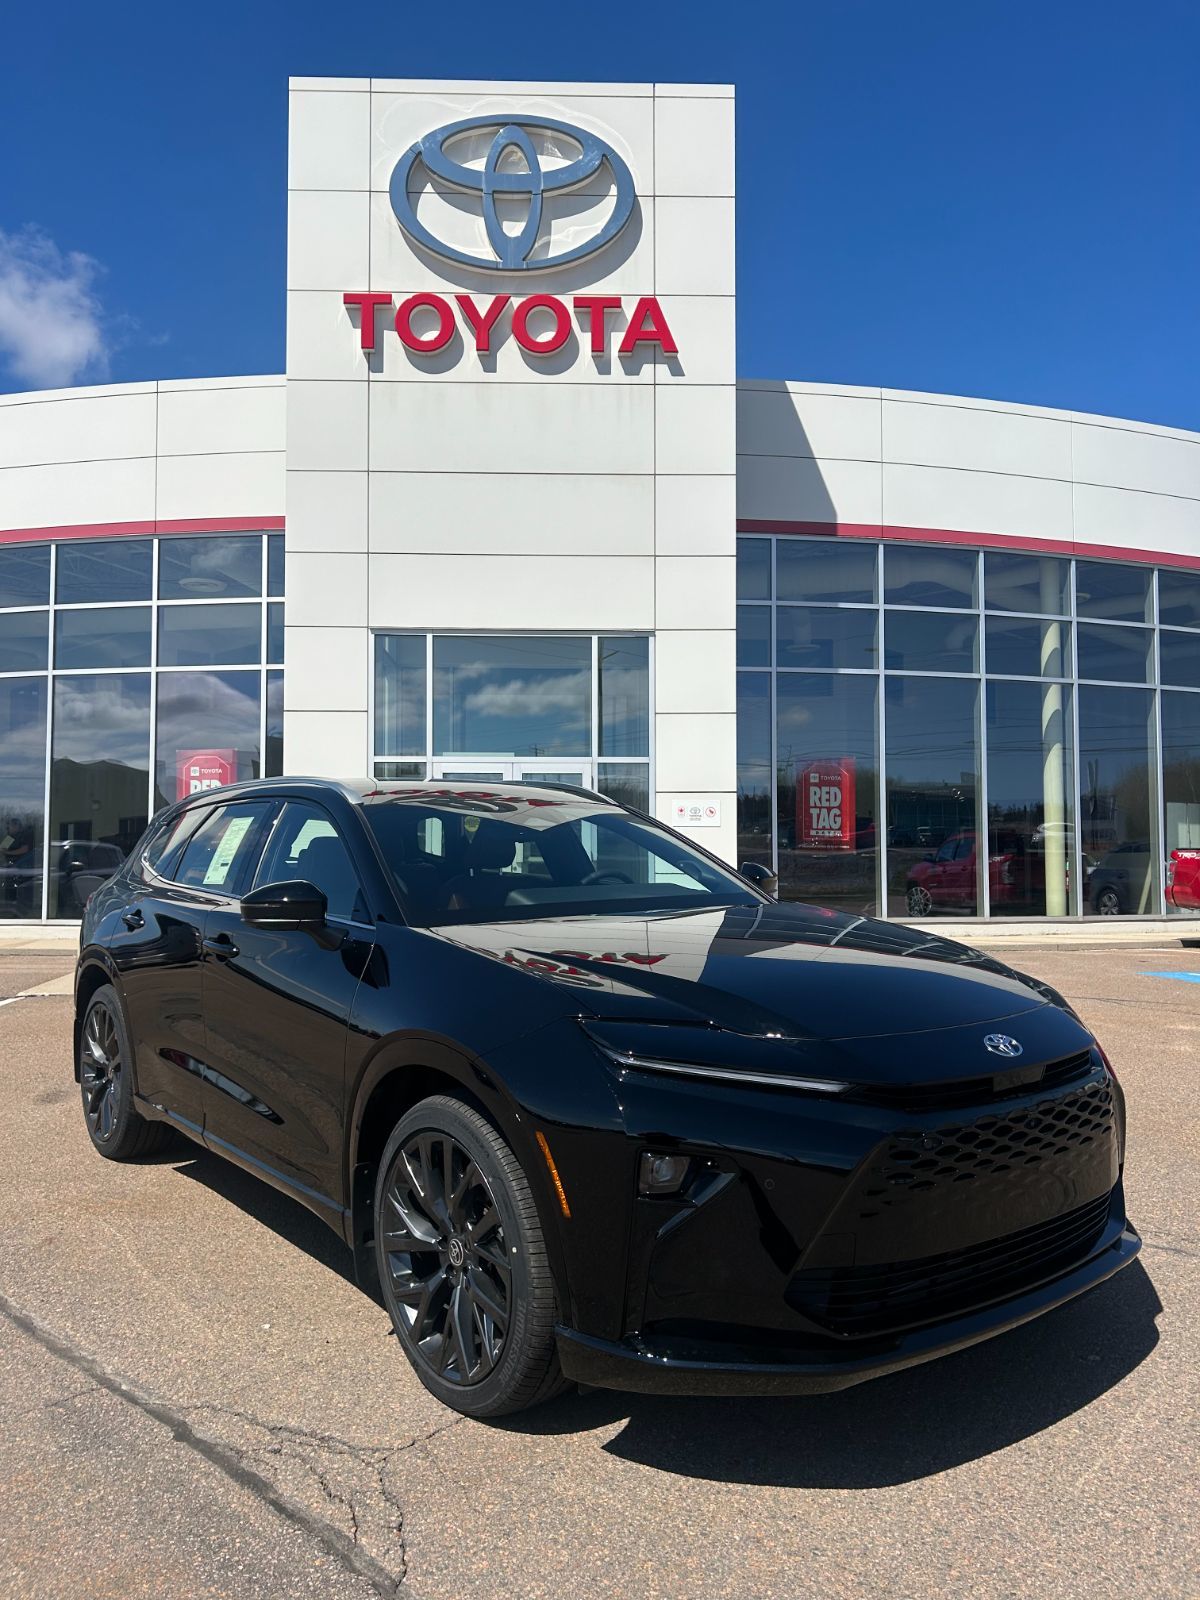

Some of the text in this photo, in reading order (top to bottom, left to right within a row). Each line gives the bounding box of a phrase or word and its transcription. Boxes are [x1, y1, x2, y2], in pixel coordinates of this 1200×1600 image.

[343, 292, 679, 354] TOYOTA
[810, 786, 842, 807] RED
[810, 808, 842, 829] TAG
